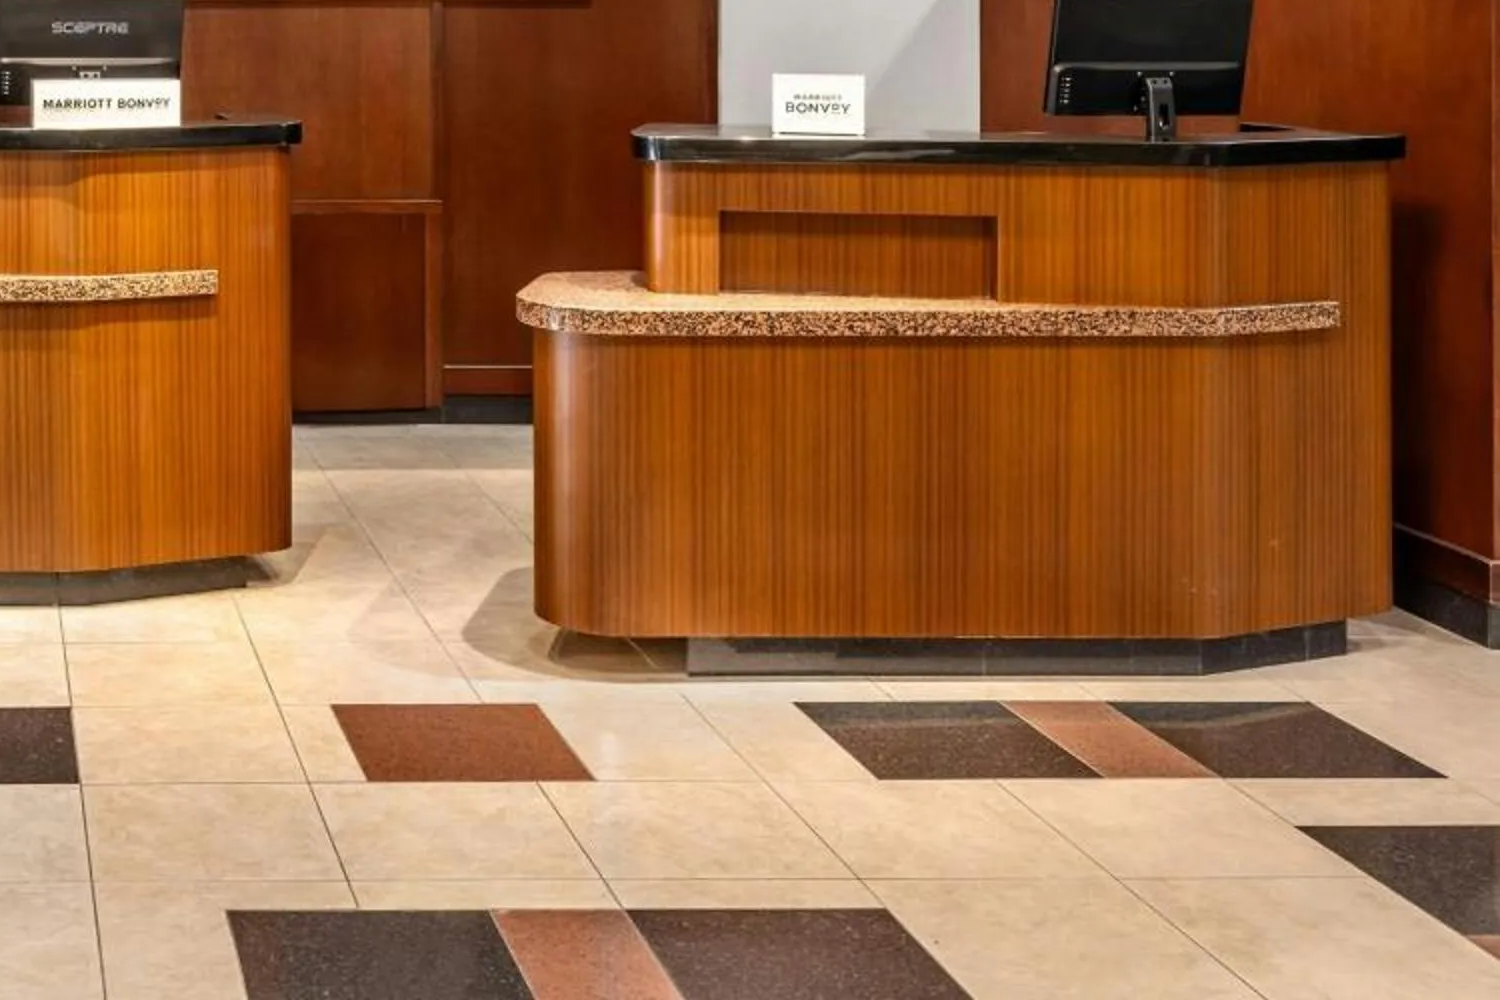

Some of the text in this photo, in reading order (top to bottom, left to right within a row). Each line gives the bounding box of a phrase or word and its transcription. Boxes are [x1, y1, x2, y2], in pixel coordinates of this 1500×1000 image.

[51, 21, 130, 35] SCEPTRE
[43, 97, 172, 110] MARRIOTT BONVOY
[785, 101, 852, 115] BONVOY
